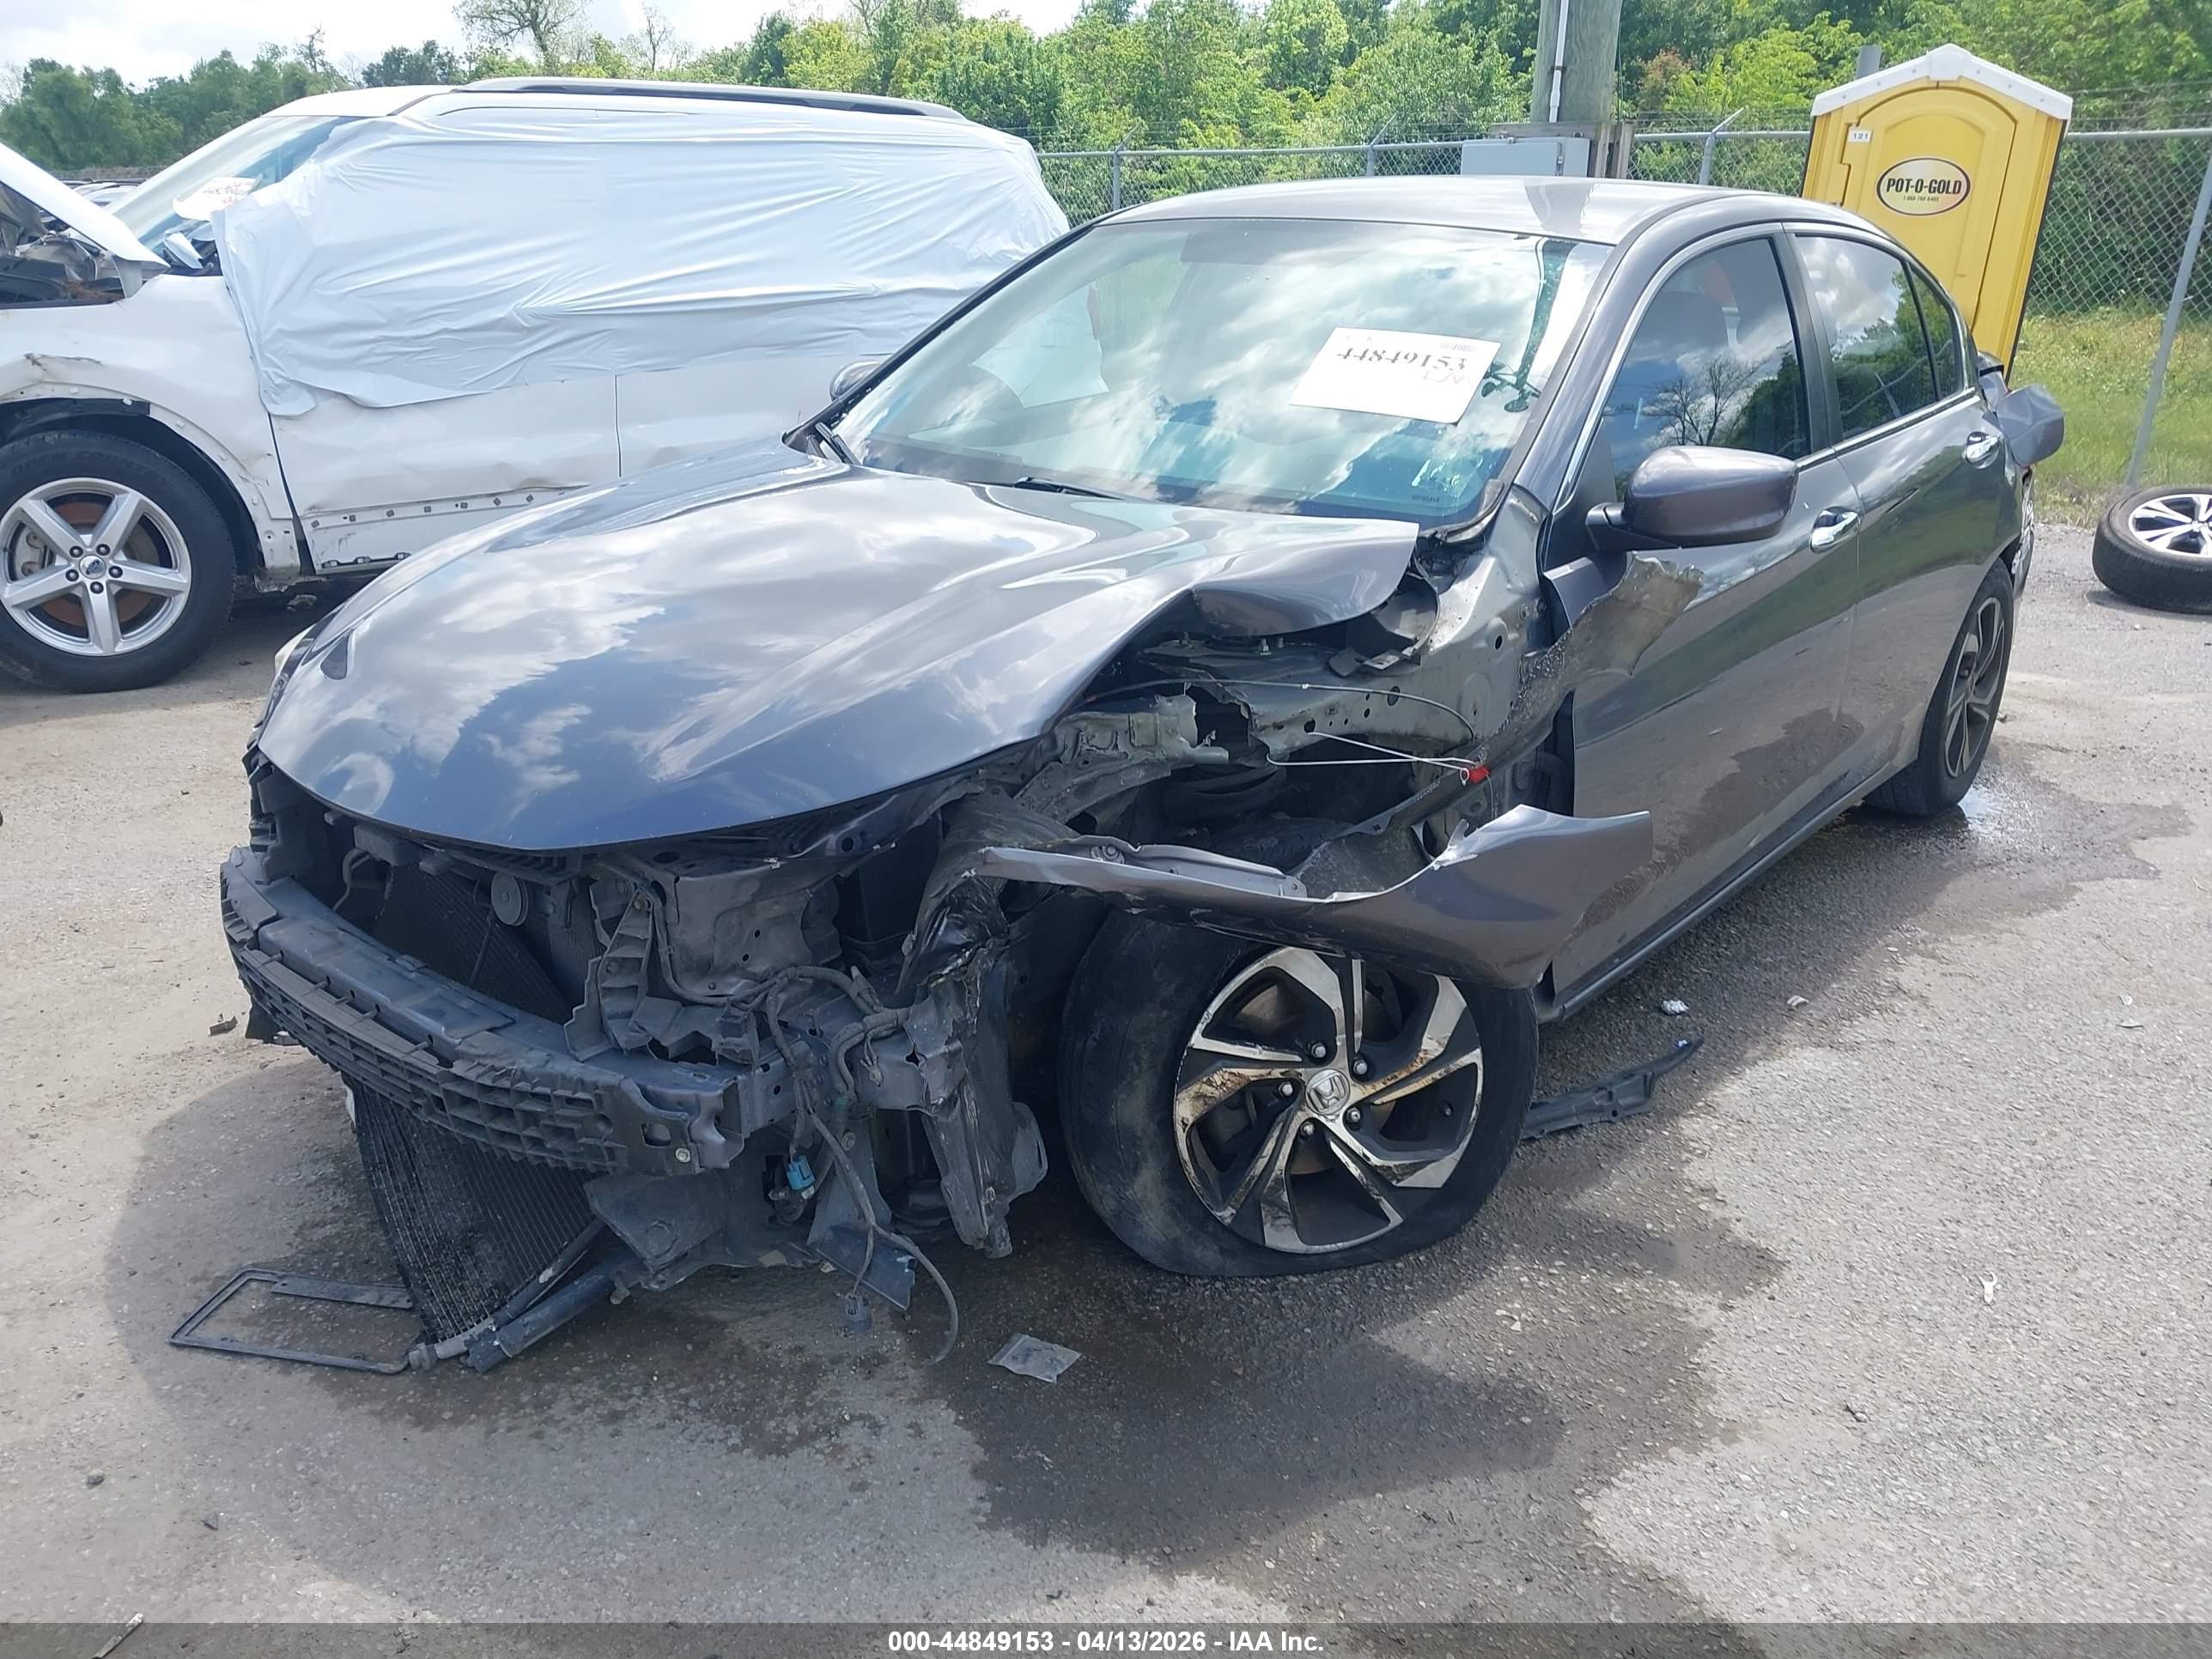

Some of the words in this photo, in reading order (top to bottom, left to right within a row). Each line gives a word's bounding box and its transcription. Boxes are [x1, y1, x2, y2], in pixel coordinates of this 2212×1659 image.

[1854, 131, 1868, 139] 121
[1886, 177, 1962, 195] POT-O-GOLD
[1336, 347, 1467, 371] 44849153
